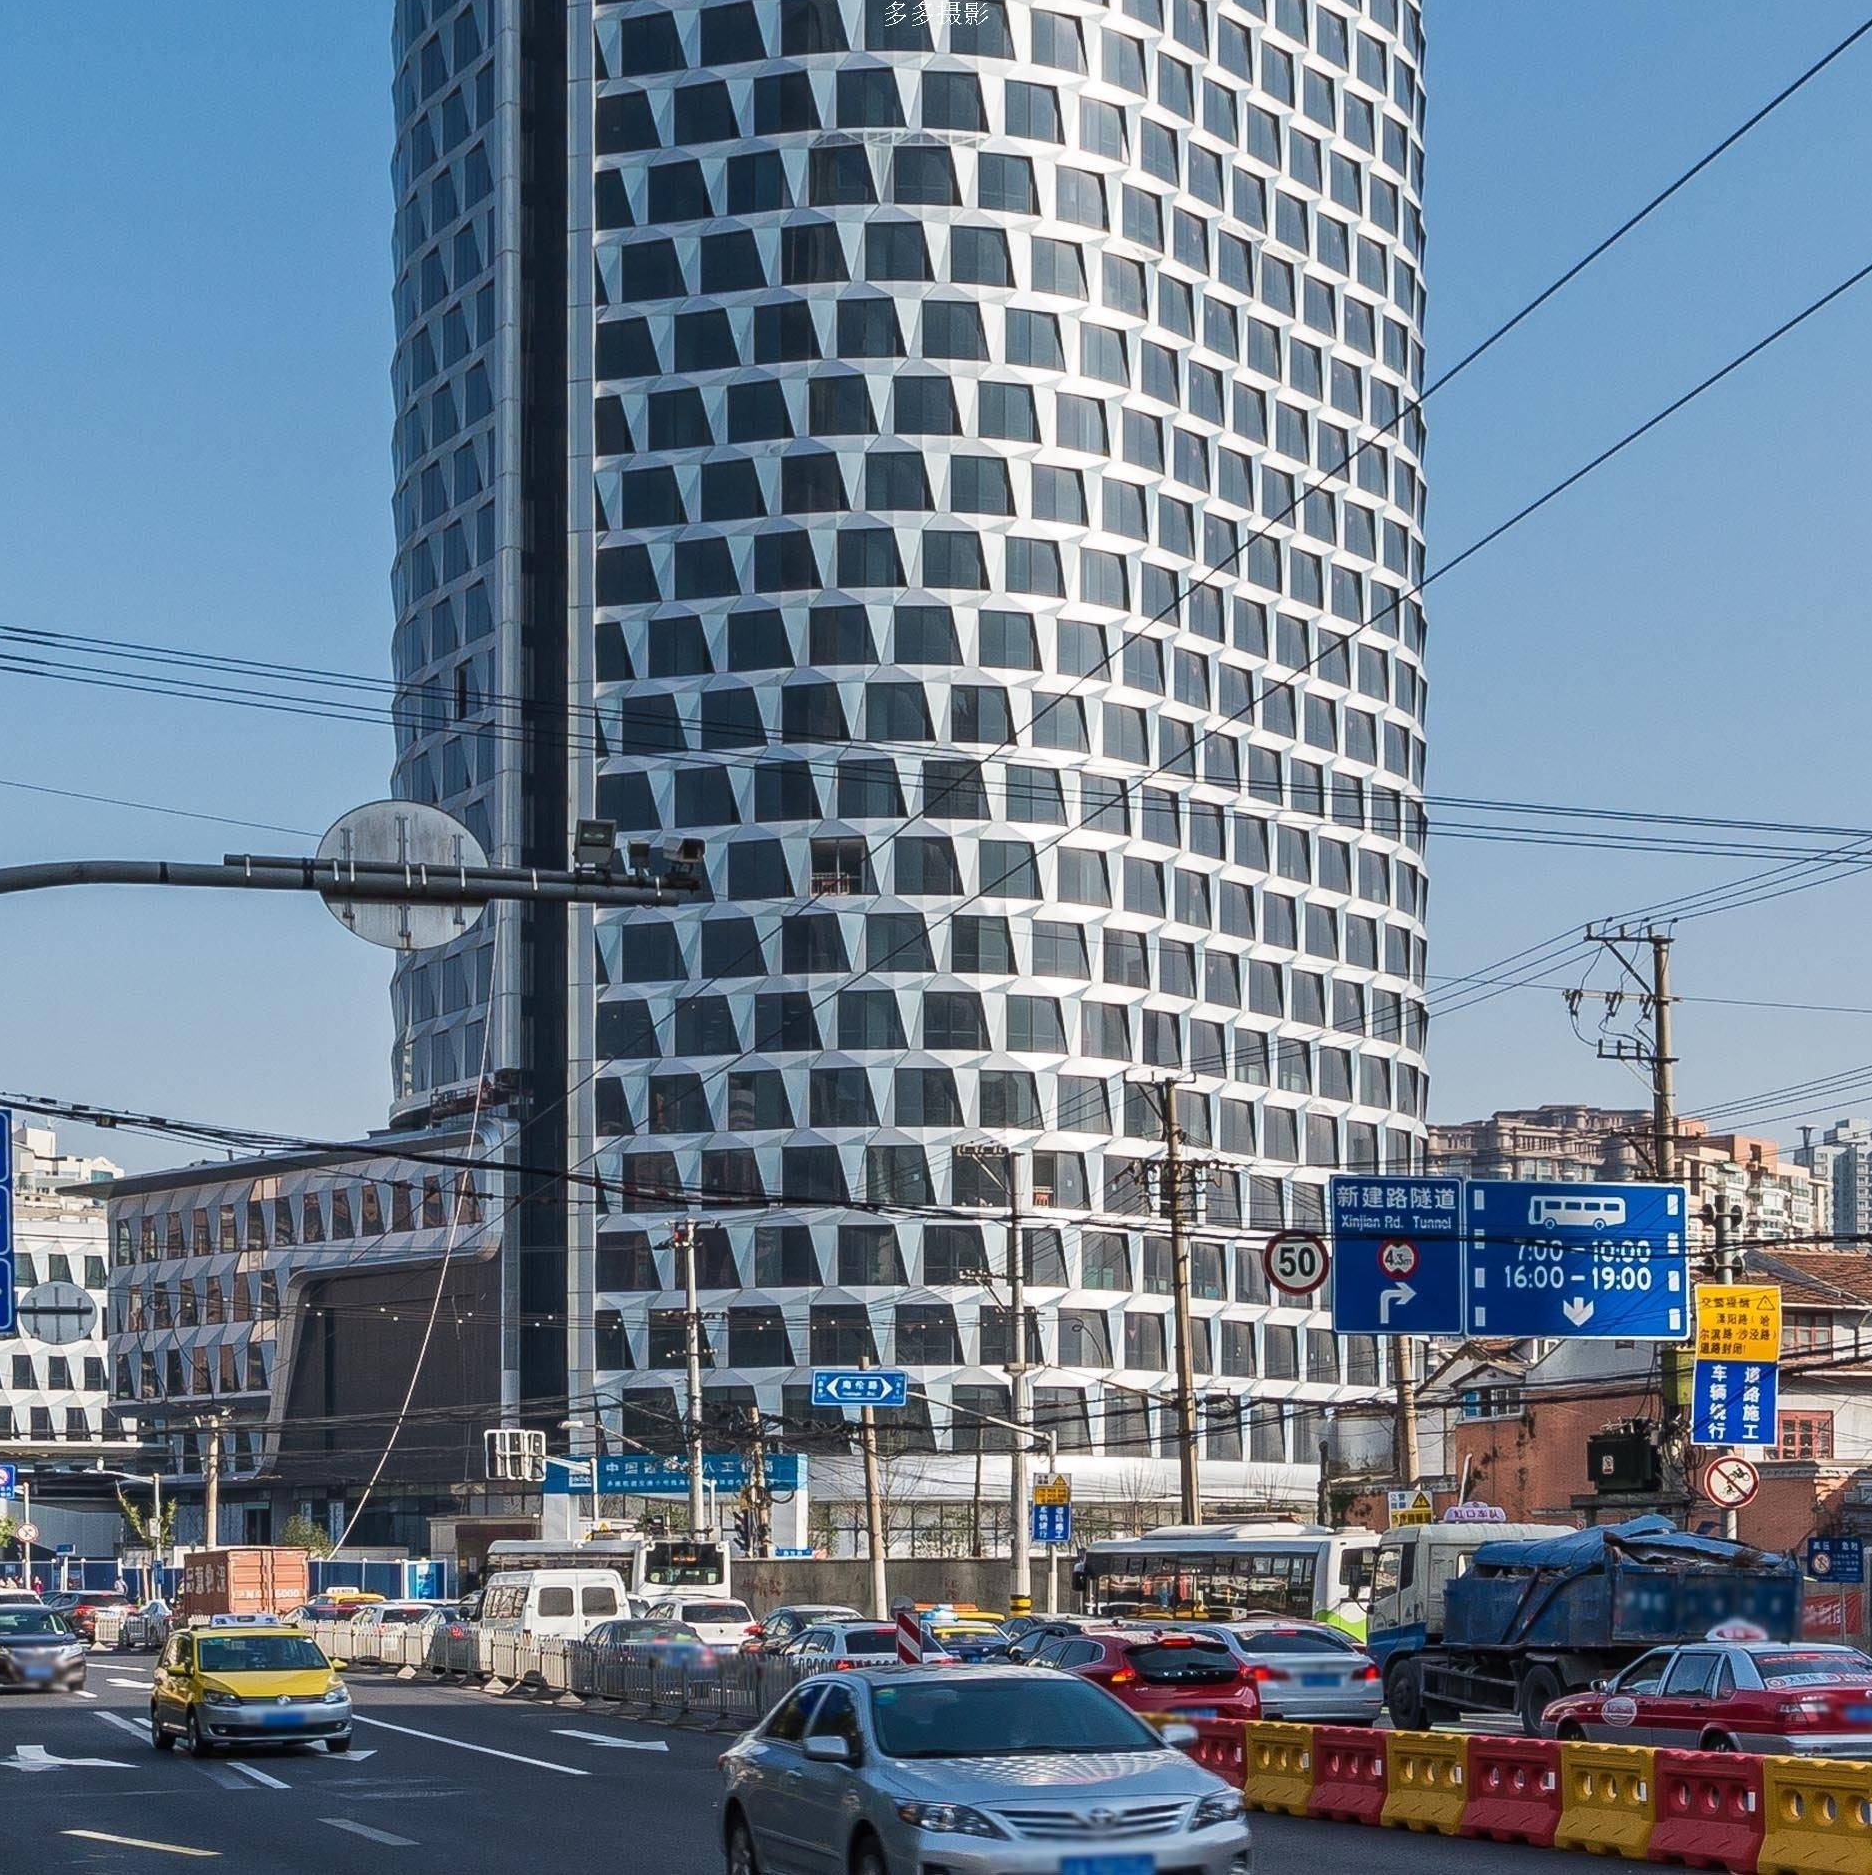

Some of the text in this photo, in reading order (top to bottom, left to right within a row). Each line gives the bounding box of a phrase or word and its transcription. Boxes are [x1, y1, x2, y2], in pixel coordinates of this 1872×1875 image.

[1336, 1185, 1456, 1210] 新建路隧道
[1341, 1214, 1452, 1232] Xinjian Rd. Tunnel
[1278, 1246, 1316, 1278] 50
[1384, 1249, 1412, 1266] 4.3m
[1708, 1364, 1728, 1440] 车辆绕行
[1742, 1366, 1761, 1440] 道路施工
[1453, 1509, 1500, 1519] 虹口车队
